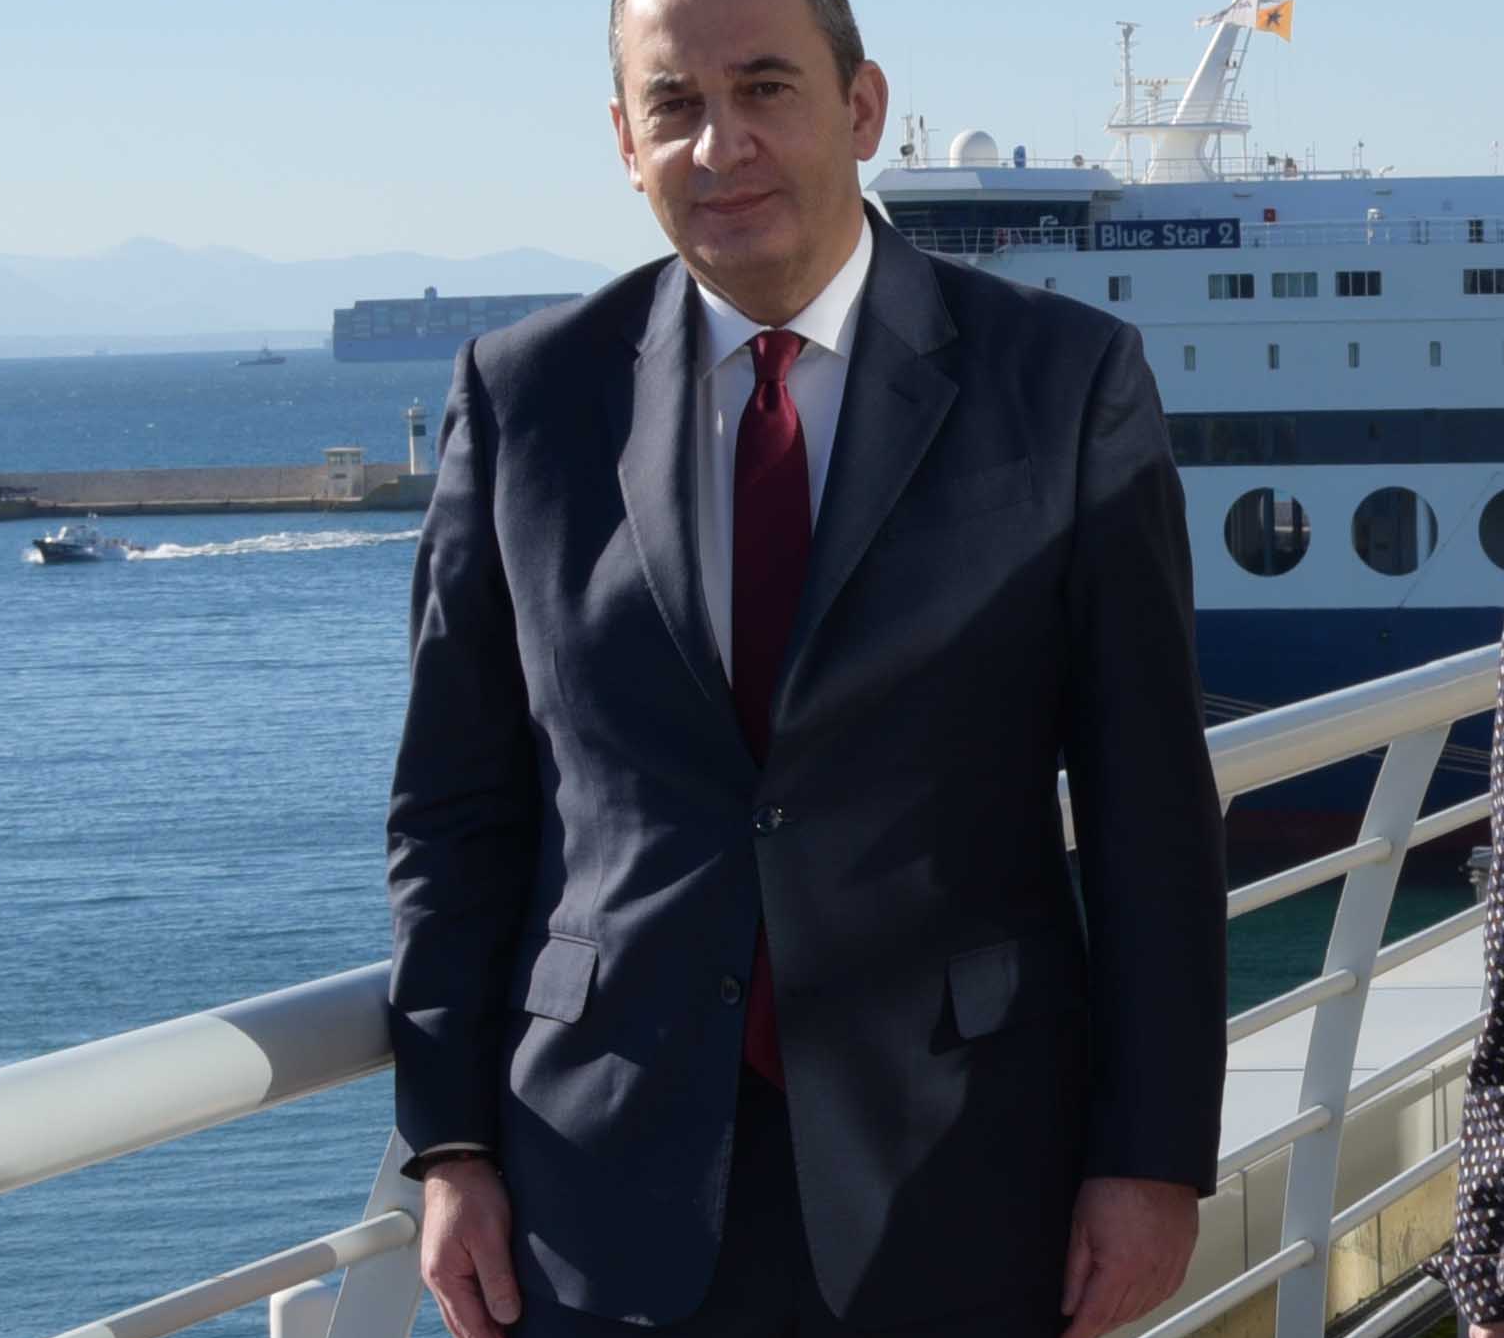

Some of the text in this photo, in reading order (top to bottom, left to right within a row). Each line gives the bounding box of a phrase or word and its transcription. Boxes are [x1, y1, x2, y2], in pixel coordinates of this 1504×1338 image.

[1101, 222, 1234, 247] Blue Star 2
